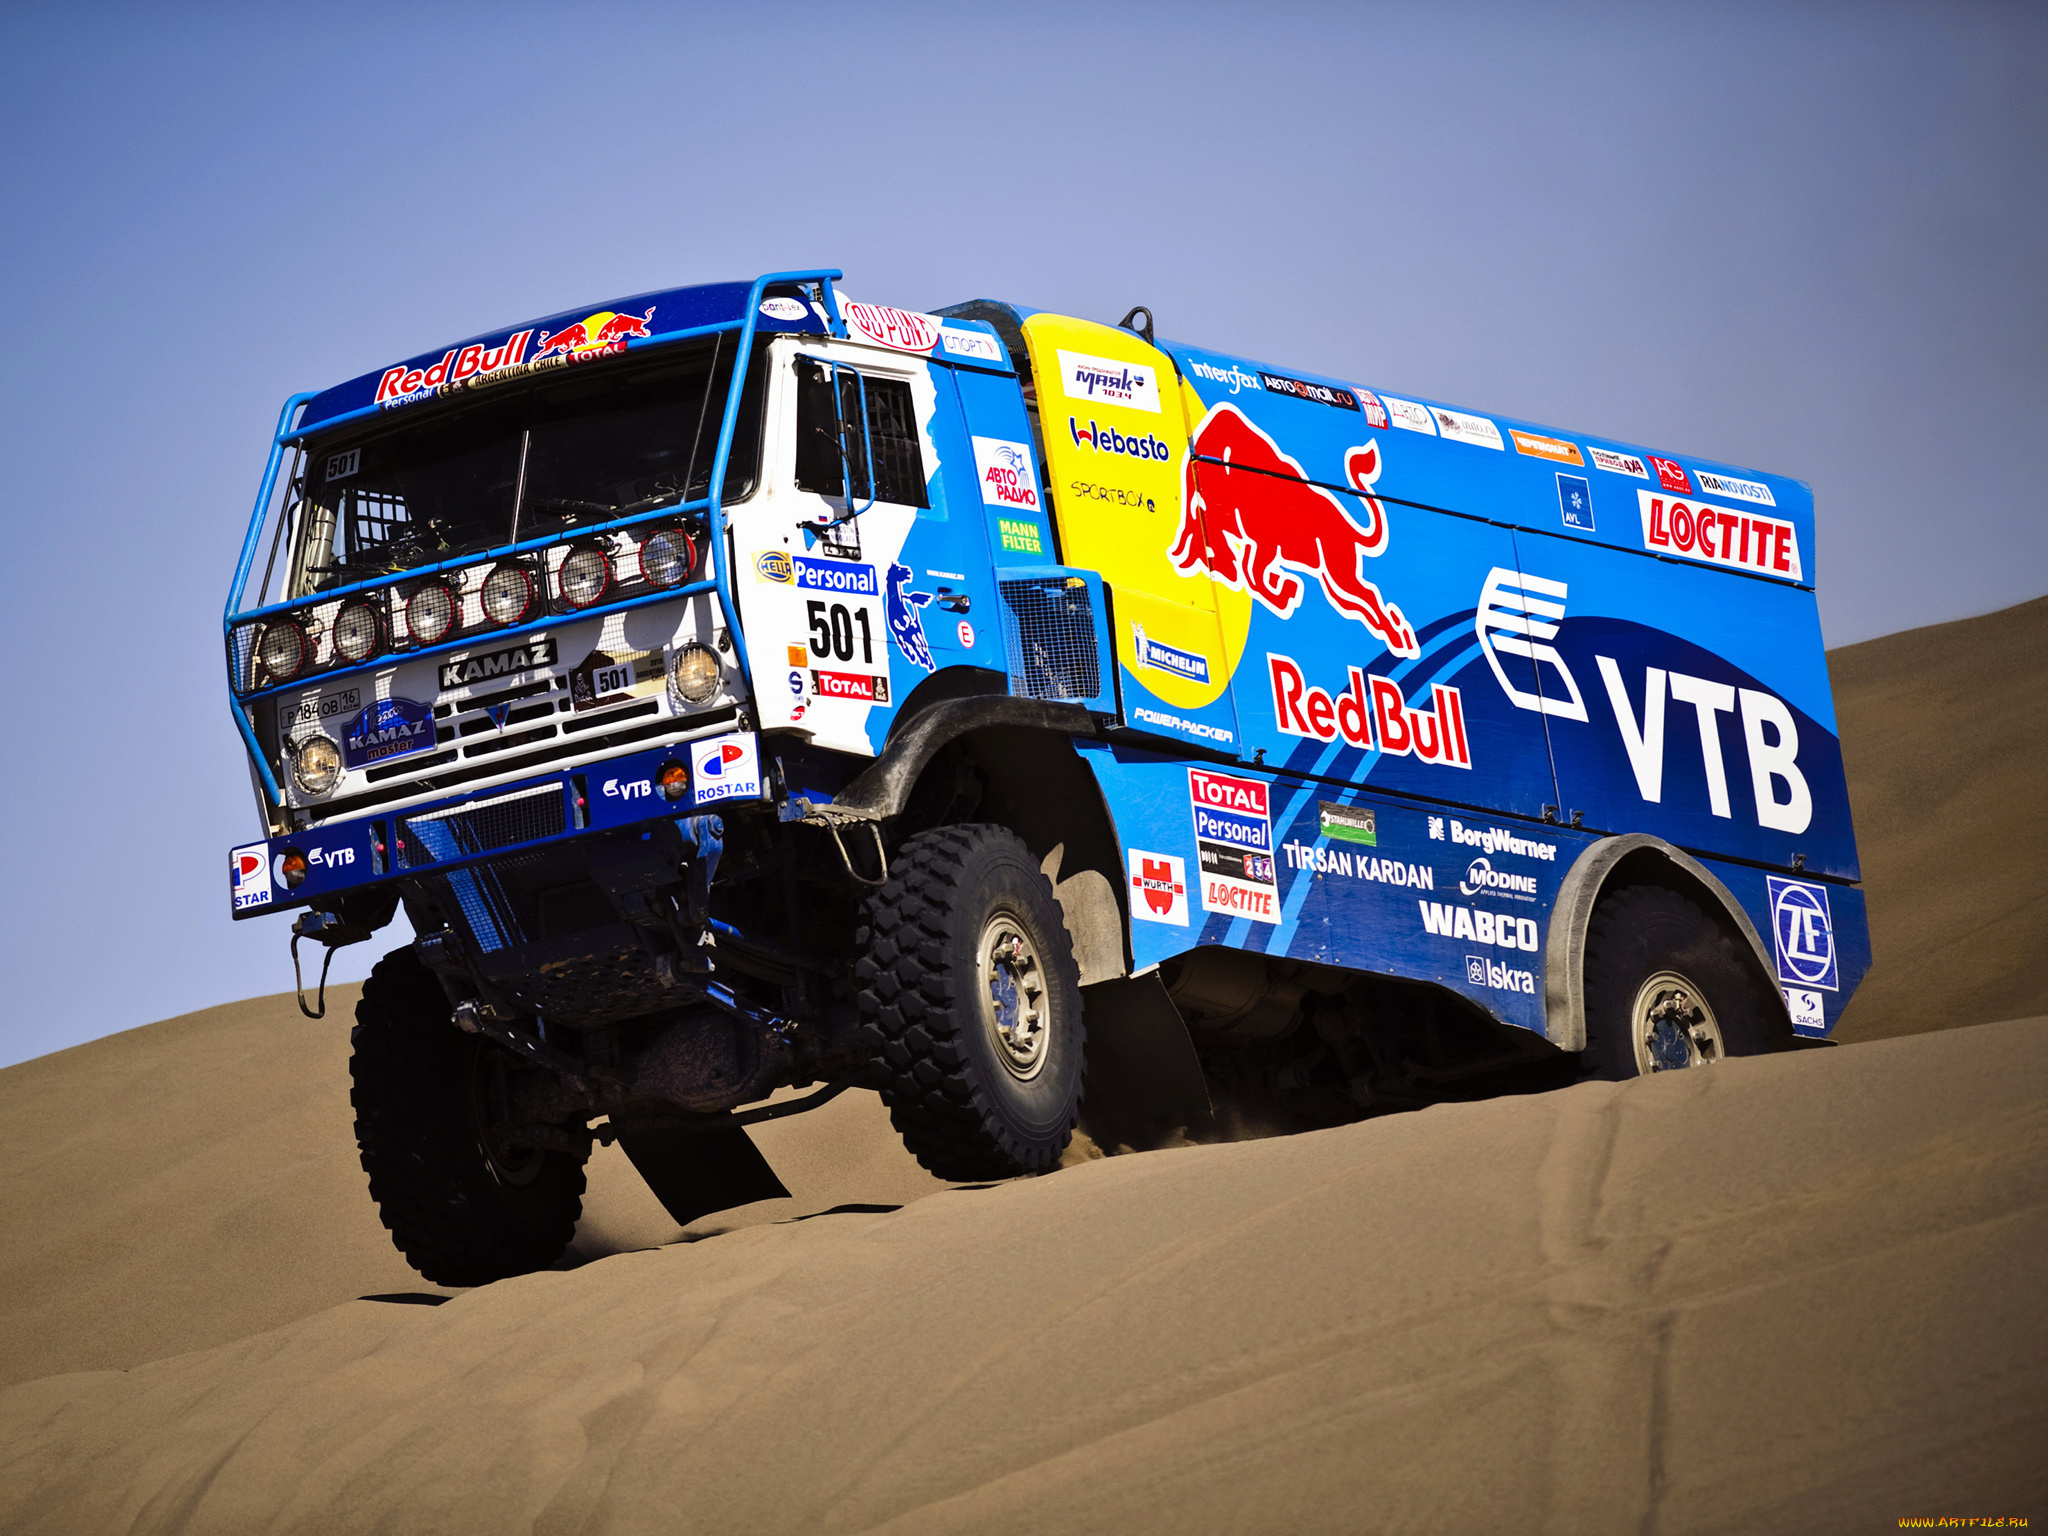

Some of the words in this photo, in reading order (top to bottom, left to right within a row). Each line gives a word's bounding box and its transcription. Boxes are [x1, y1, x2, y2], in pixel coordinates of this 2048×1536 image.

[375, 350, 457, 403] Red
[453, 330, 533, 382] Bull
[570, 344, 625, 363] TOTAL
[474, 364, 531, 388] ARGENTINA
[533, 357, 562, 373] CHILE
[1188, 359, 1262, 395] interfax
[385, 387, 433, 410] Personal
[1068, 416, 1169, 462] Webasto
[328, 456, 356, 479] 501
[985, 466, 1017, 487] АВТО
[997, 484, 1036, 506] РАДИО
[1000, 519, 1039, 539] MANN
[1565, 512, 1581, 525] AVL
[1002, 534, 1042, 553] FILTER
[1648, 498, 1793, 573] LOCTITE
[760, 561, 792, 576] HELLA
[794, 560, 875, 592] Personal
[807, 599, 873, 664] 501
[442, 645, 550, 691] KAMAZ
[1149, 647, 1206, 676] MICHELIN
[599, 667, 629, 693] 501
[820, 674, 872, 697] TOTAL
[342, 691, 356, 705] 16
[1271, 657, 1372, 746] Red
[1372, 678, 1469, 764] Bull
[349, 720, 426, 750] KAMAZ
[1134, 706, 1234, 743] POWER-PACKER
[368, 740, 413, 759] master
[1595, 655, 1813, 835] VTB
[620, 779, 651, 800] VTB
[697, 782, 756, 801] ROSTAR
[1192, 774, 1265, 811] TOTAL
[1198, 811, 1267, 846] Personal
[1450, 819, 1557, 862] BorgWarner
[324, 847, 356, 869] VTB
[1355, 855, 1434, 891] KARDAN
[1469, 868, 1538, 894] MODINE
[1208, 881, 1273, 915] LOCTITE
[1418, 900, 1539, 953] WABCO
[1778, 902, 1830, 965] ZF
[1485, 958, 1536, 994] Iskra
[1796, 1014, 1824, 1027] SACHS
